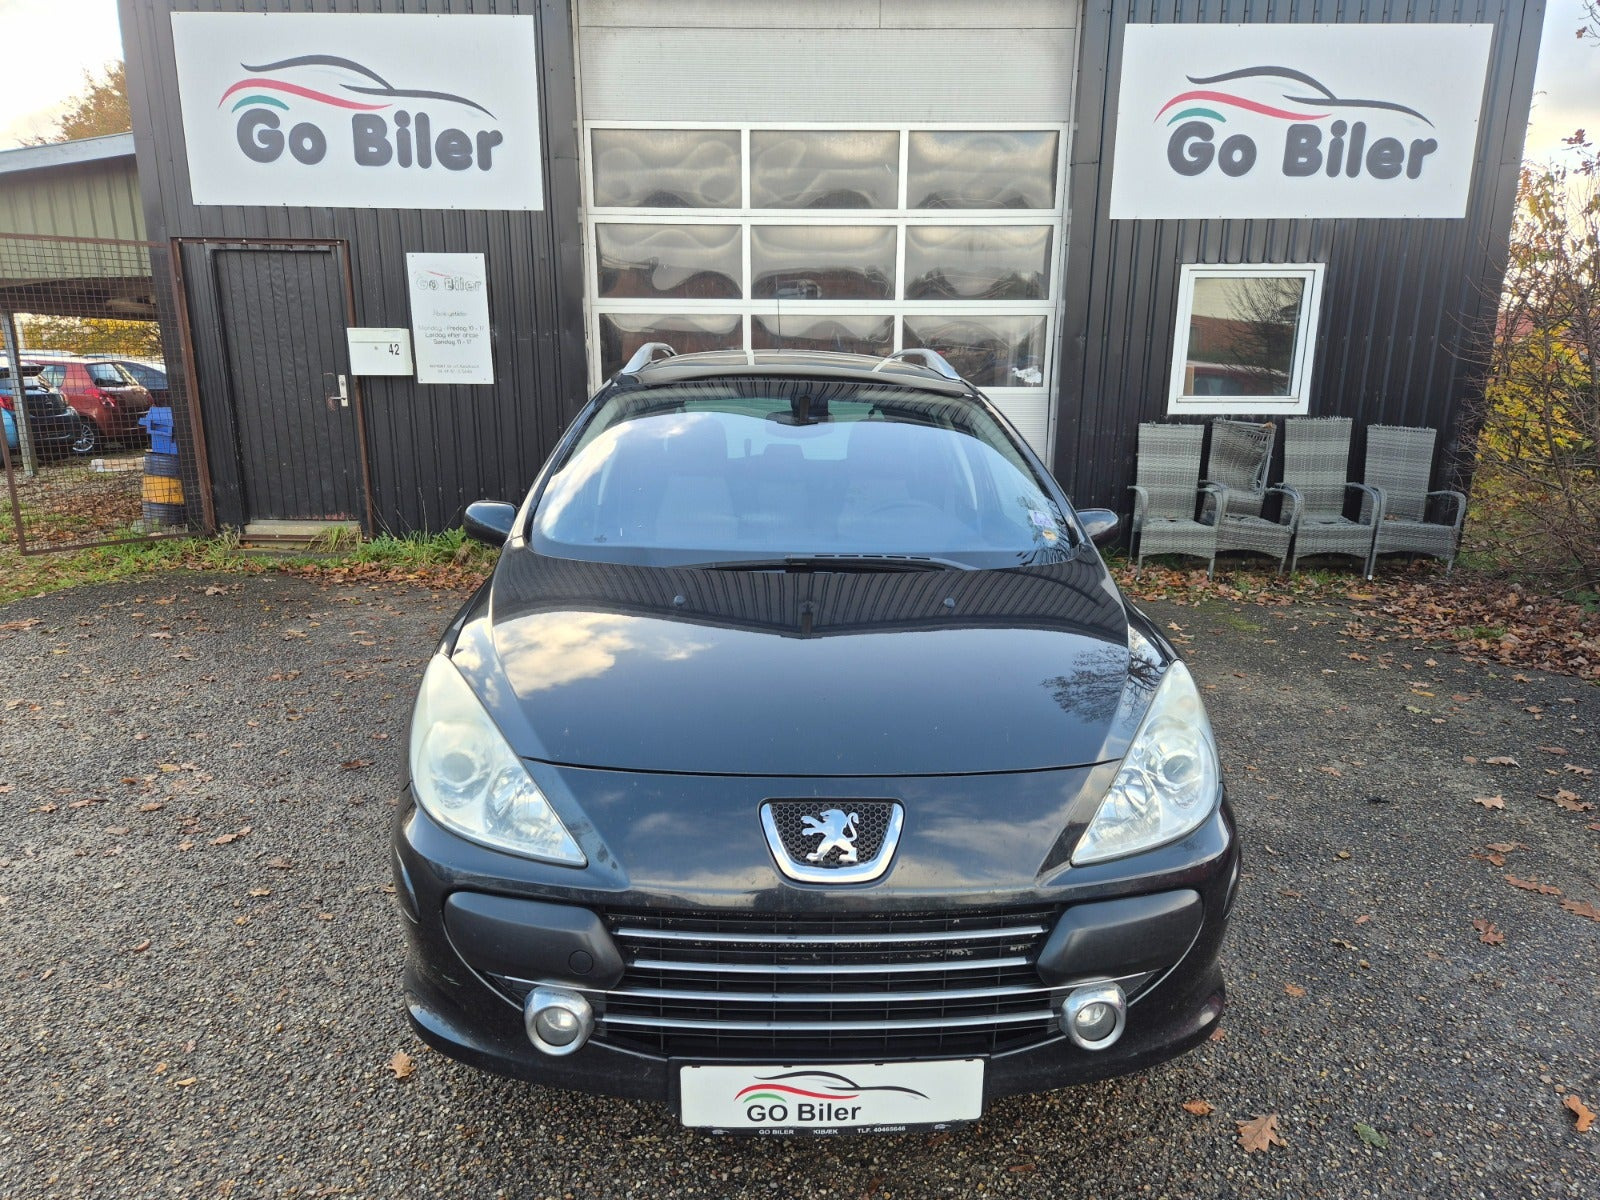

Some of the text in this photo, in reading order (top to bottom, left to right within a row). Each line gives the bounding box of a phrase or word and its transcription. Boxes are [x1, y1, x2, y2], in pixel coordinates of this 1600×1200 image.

[237, 108, 503, 171] Go Biler
[1167, 120, 1438, 179] Go Biler
[444, 277, 481, 291] Biler
[388, 343, 400, 356] 42
[747, 1103, 861, 1122] GO Biler
